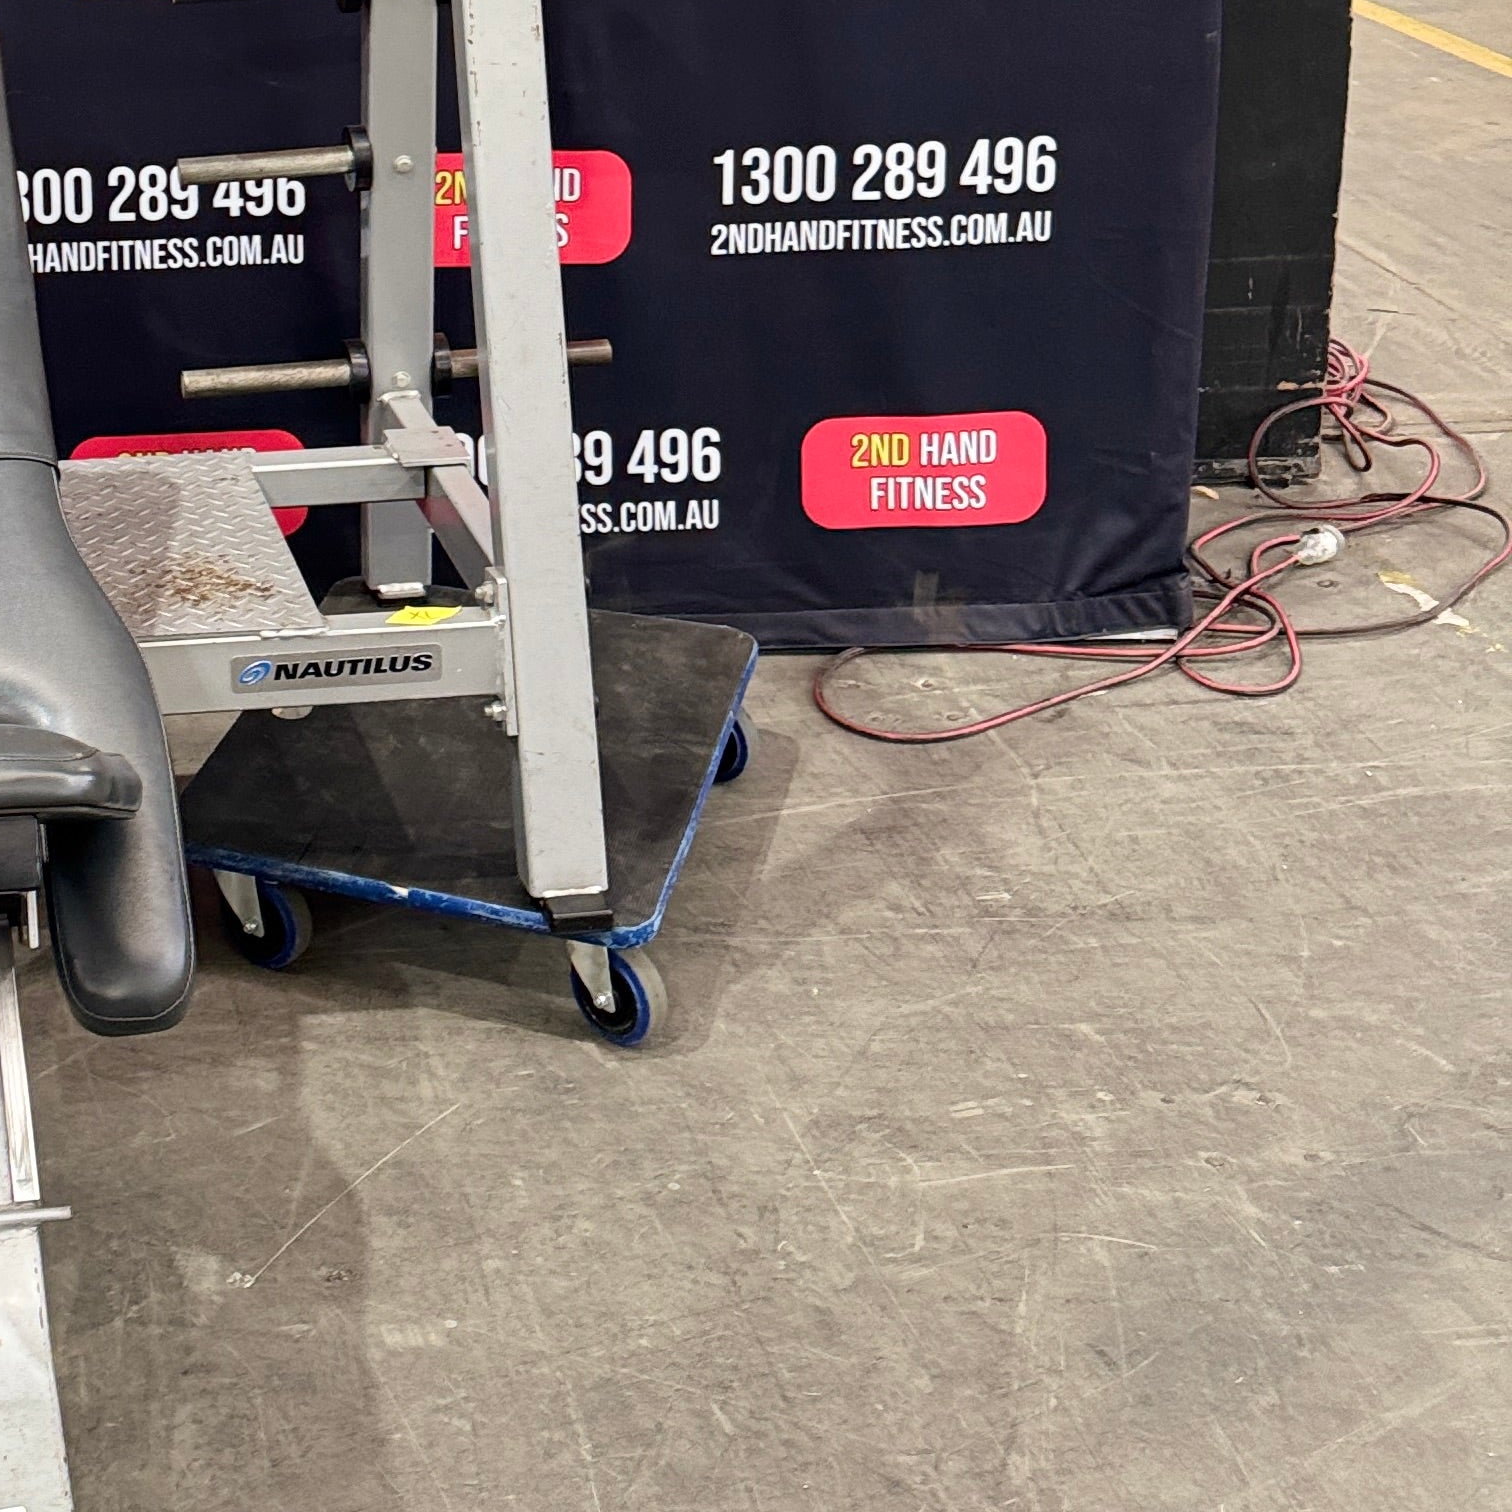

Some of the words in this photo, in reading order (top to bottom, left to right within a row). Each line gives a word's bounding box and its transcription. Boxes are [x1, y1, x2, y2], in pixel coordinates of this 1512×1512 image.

[713, 144, 837, 206] 1300
[852, 140, 946, 201] 289
[959, 135, 1057, 195] 496
[107, 165, 198, 222] 289
[29, 234, 305, 273] HANDFITNESS.COM.AU
[710, 210, 1052, 256] 2NDHANDFITNESS.COM.AU
[627, 426, 721, 484] 496
[851, 433, 910, 468] 2ND
[920, 429, 997, 466] HAND
[870, 474, 987, 510] FITNESS
[274, 654, 433, 680] NAUTILUS
